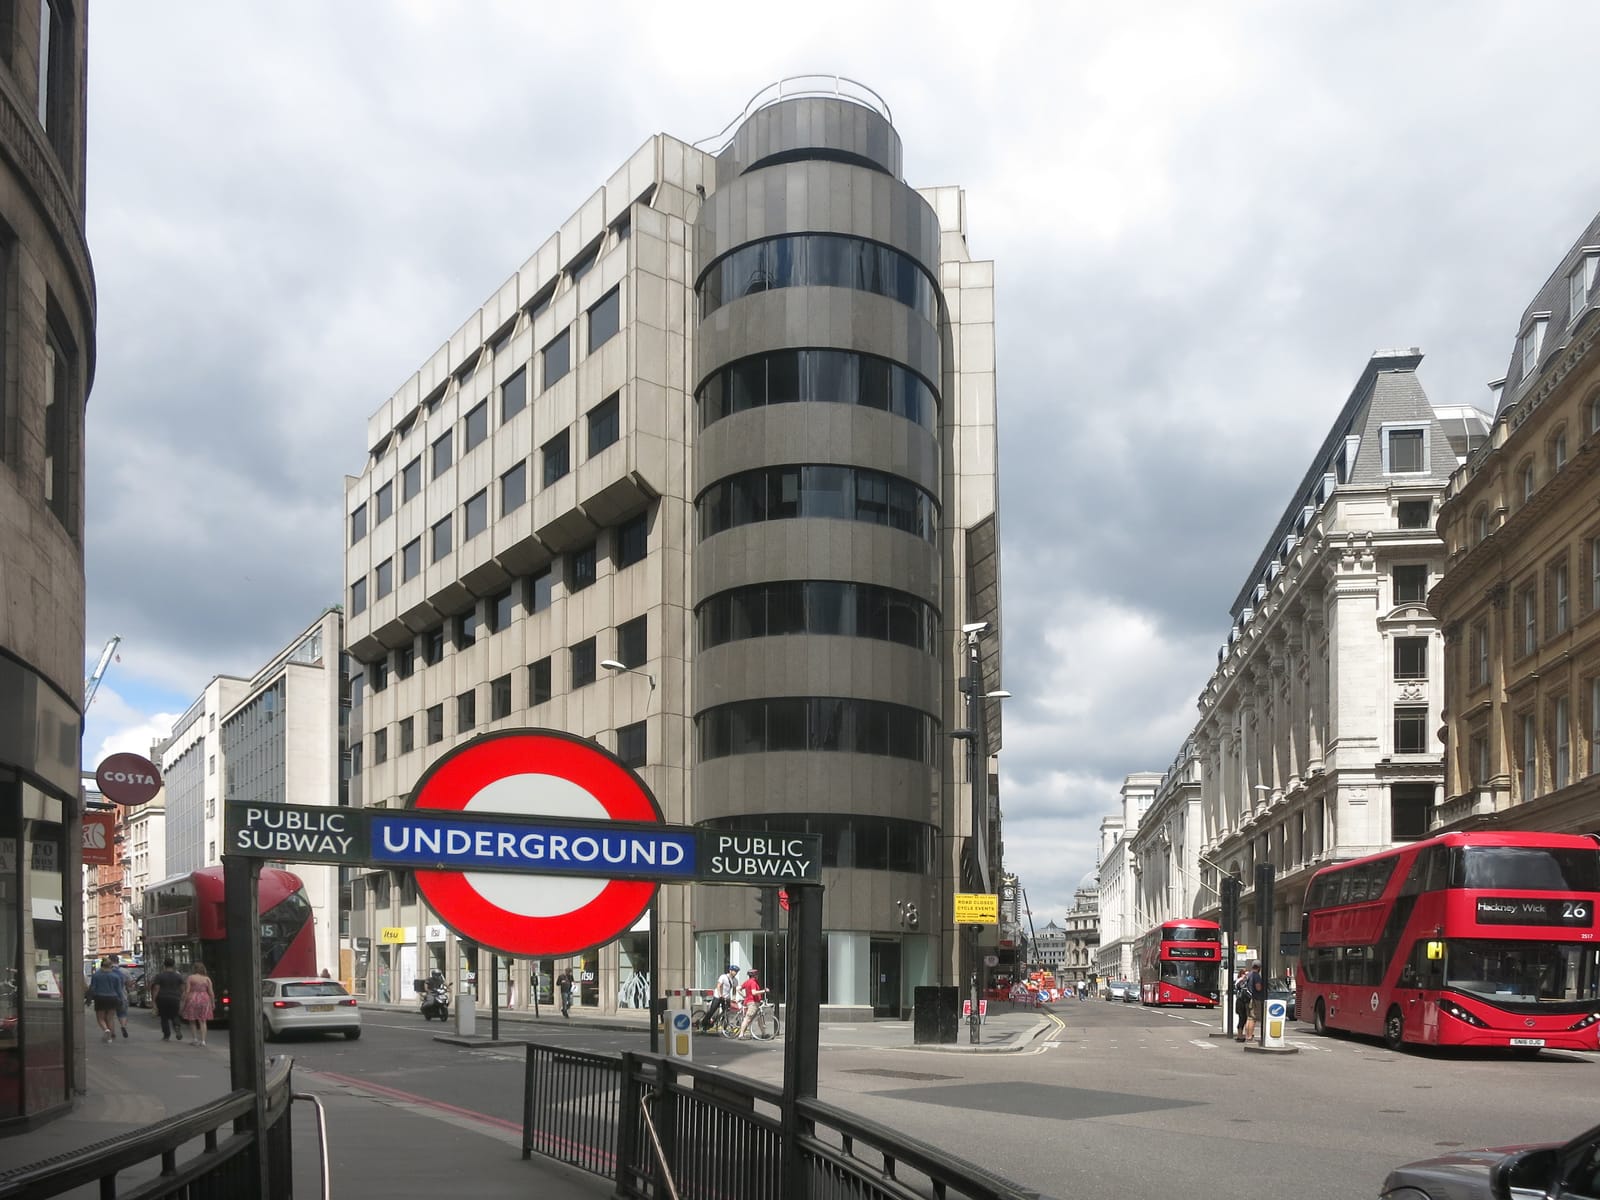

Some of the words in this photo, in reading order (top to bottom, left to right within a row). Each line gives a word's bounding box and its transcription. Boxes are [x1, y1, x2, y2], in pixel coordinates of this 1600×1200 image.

[103, 771, 155, 785] COSTA
[247, 808, 345, 833] PUBLIC
[237, 830, 353, 855] SUBWAY
[383, 826, 685, 867] UNDERGROUND
[719, 836, 803, 857] PUBLIC
[711, 856, 810, 877] SUBWAY
[1478, 903, 1517, 914] Hackney
[1522, 903, 1546, 913] Wick
[1563, 903, 1586, 918] 26
[383, 929, 399, 939] itsu
